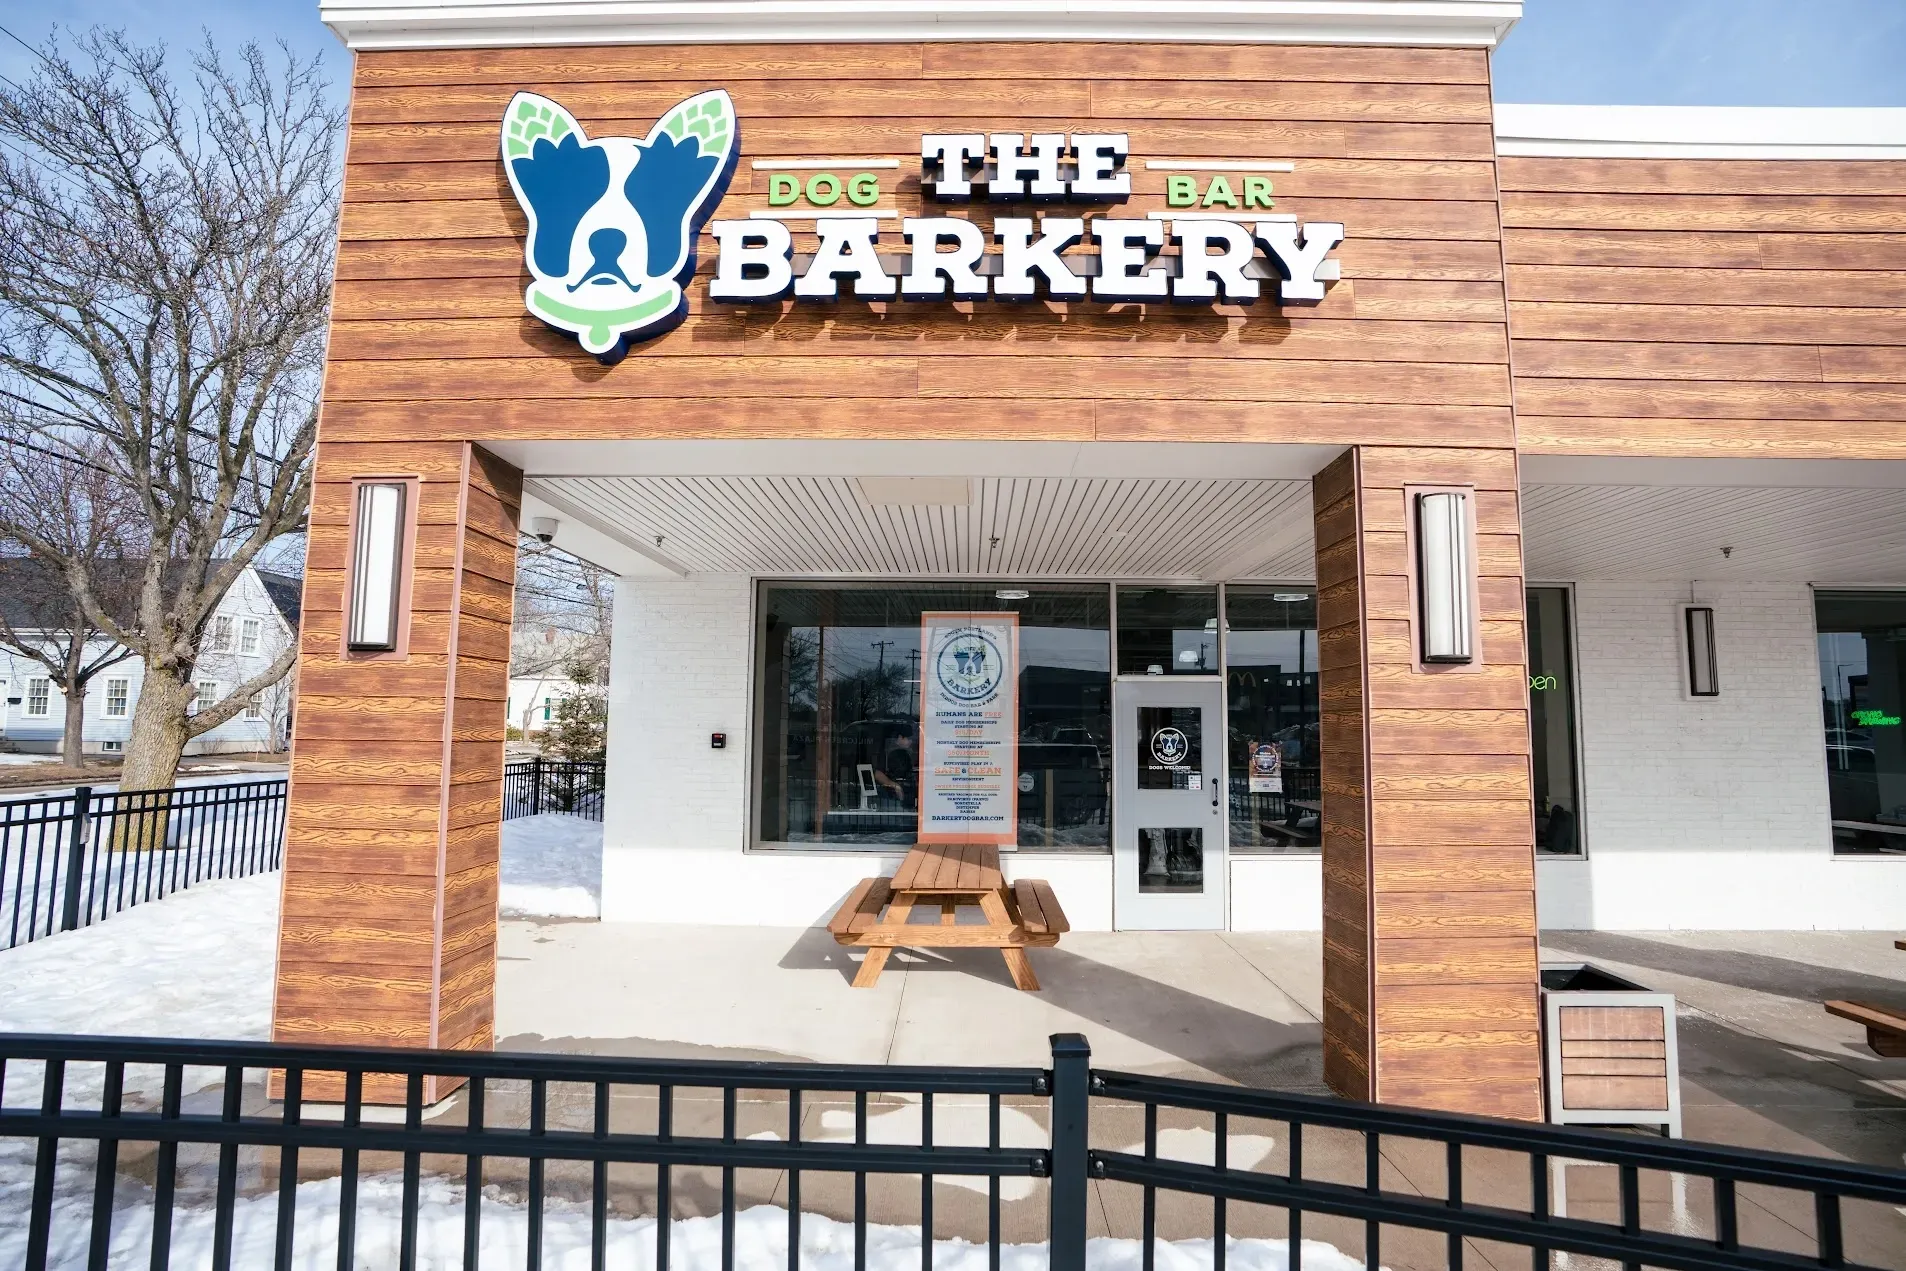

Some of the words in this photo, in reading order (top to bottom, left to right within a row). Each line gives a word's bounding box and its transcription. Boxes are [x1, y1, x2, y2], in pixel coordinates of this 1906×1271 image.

[921, 133, 1129, 200] THE
[769, 174, 881, 207] DOG
[1167, 176, 1275, 208] BAR
[711, 217, 1344, 302] BARKERY
[946, 677, 992, 695] BARKERY
[1529, 675, 1557, 690] en
[1156, 751, 1183, 762] BARKERY
